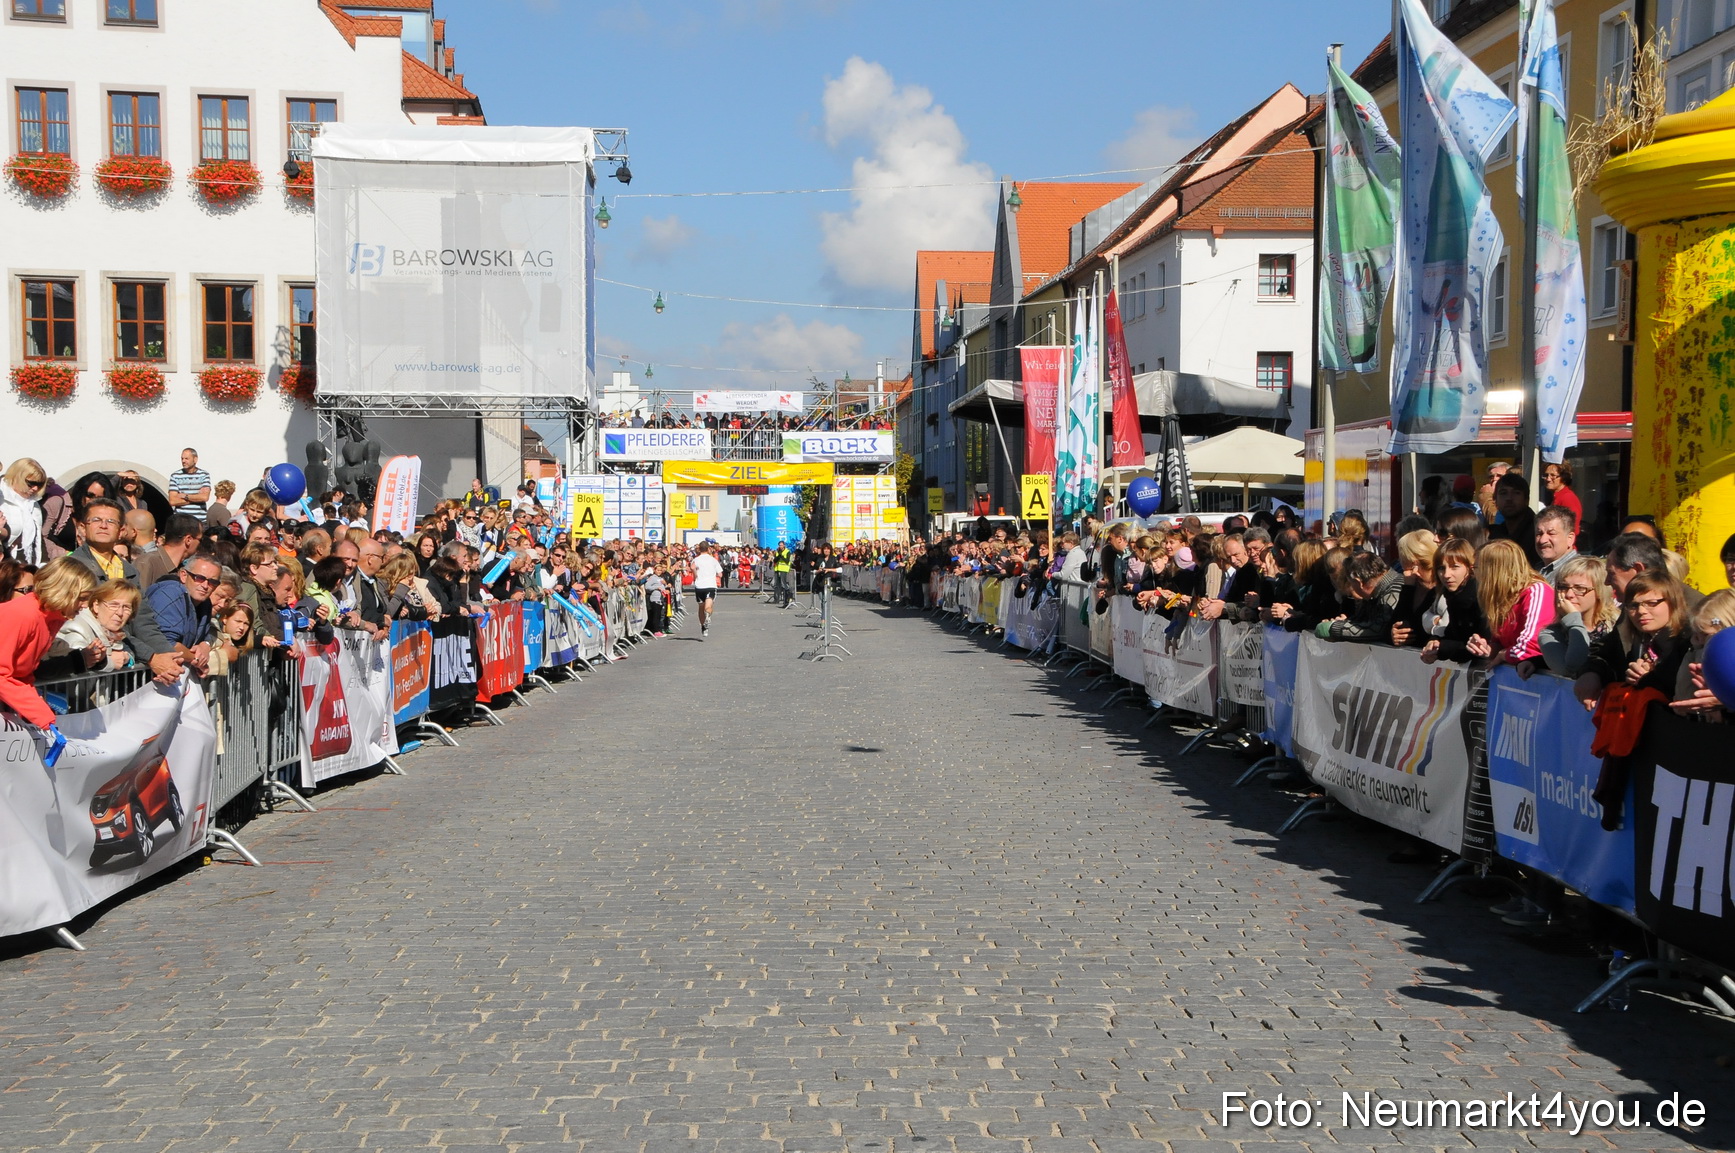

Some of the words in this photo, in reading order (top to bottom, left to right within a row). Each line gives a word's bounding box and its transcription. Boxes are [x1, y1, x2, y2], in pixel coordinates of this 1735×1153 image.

[393, 249, 513, 267] BAROWSKI
[521, 250, 553, 267] AG
[394, 268, 462, 277] Veranstaltungs-
[485, 269, 553, 277] Mediensysteme
[395, 362, 521, 375] www.barowski-ag.de
[1024, 360, 1043, 370] Wir
[628, 433, 706, 447] PFLEIDERER
[802, 438, 878, 454] BOCK
[628, 448, 706, 456] AKTIENGESELLSCHAFT
[730, 466, 768, 480] ZIEL
[1025, 476, 1048, 485] Block
[381, 467, 399, 529] KLEBL
[396, 474, 407, 519] www.klebl.de
[577, 494, 601, 503] Block
[1029, 488, 1045, 509] A
[579, 506, 596, 528] A
[1331, 681, 1414, 769] swn
[1494, 710, 1535, 767] maxi
[1321, 760, 1366, 795] stadtwerke
[1369, 777, 1431, 814] neumarkt
[1513, 797, 1534, 835] dsl
